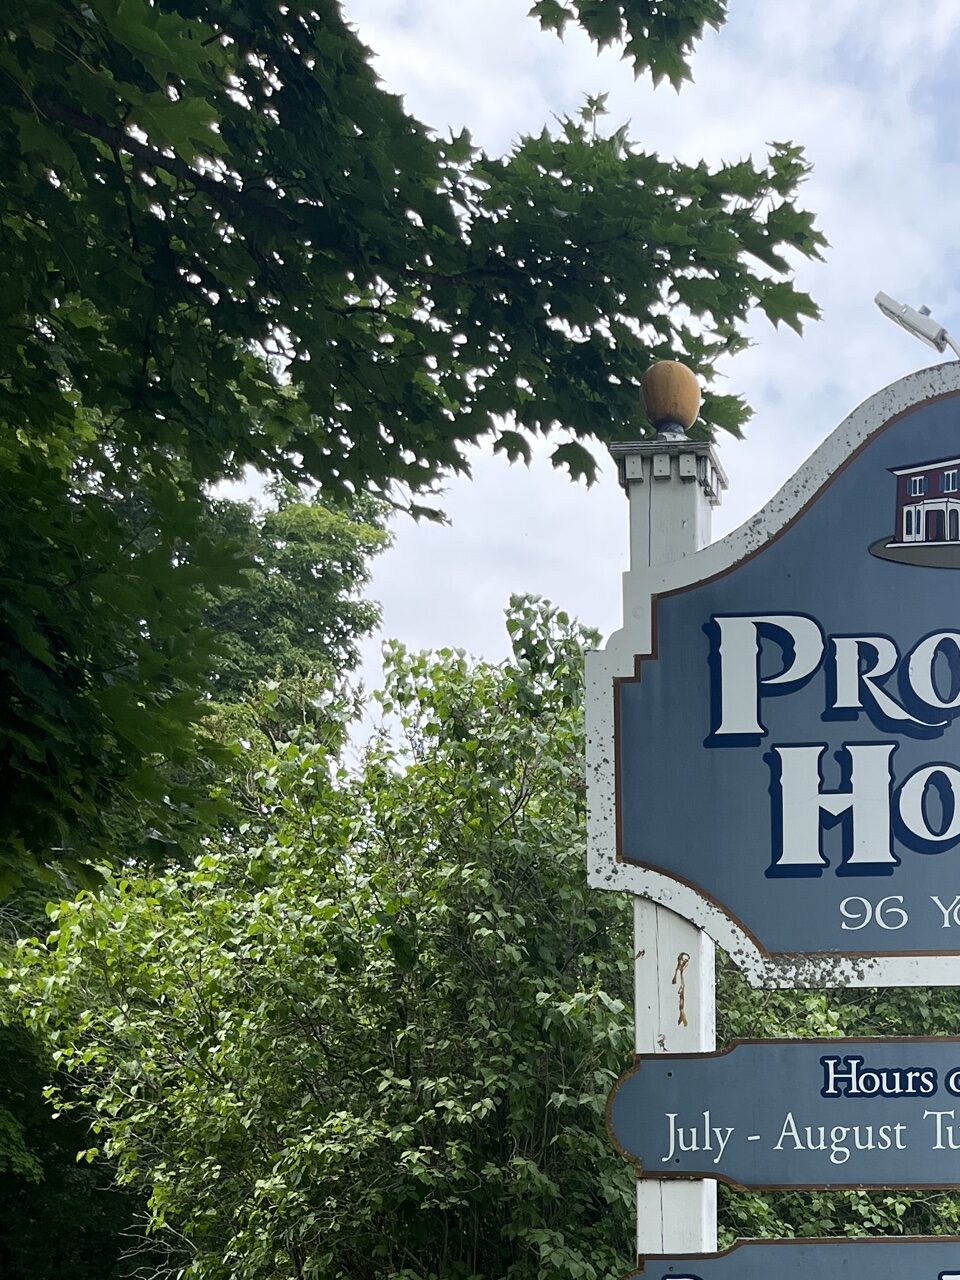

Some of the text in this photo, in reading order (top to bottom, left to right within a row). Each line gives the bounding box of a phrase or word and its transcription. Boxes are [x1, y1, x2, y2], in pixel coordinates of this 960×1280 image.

[839, 895, 909, 931] 96
[823, 1057, 935, 1096] Hours
[661, 1110, 735, 1165] July
[772, 1112, 908, 1165] August
